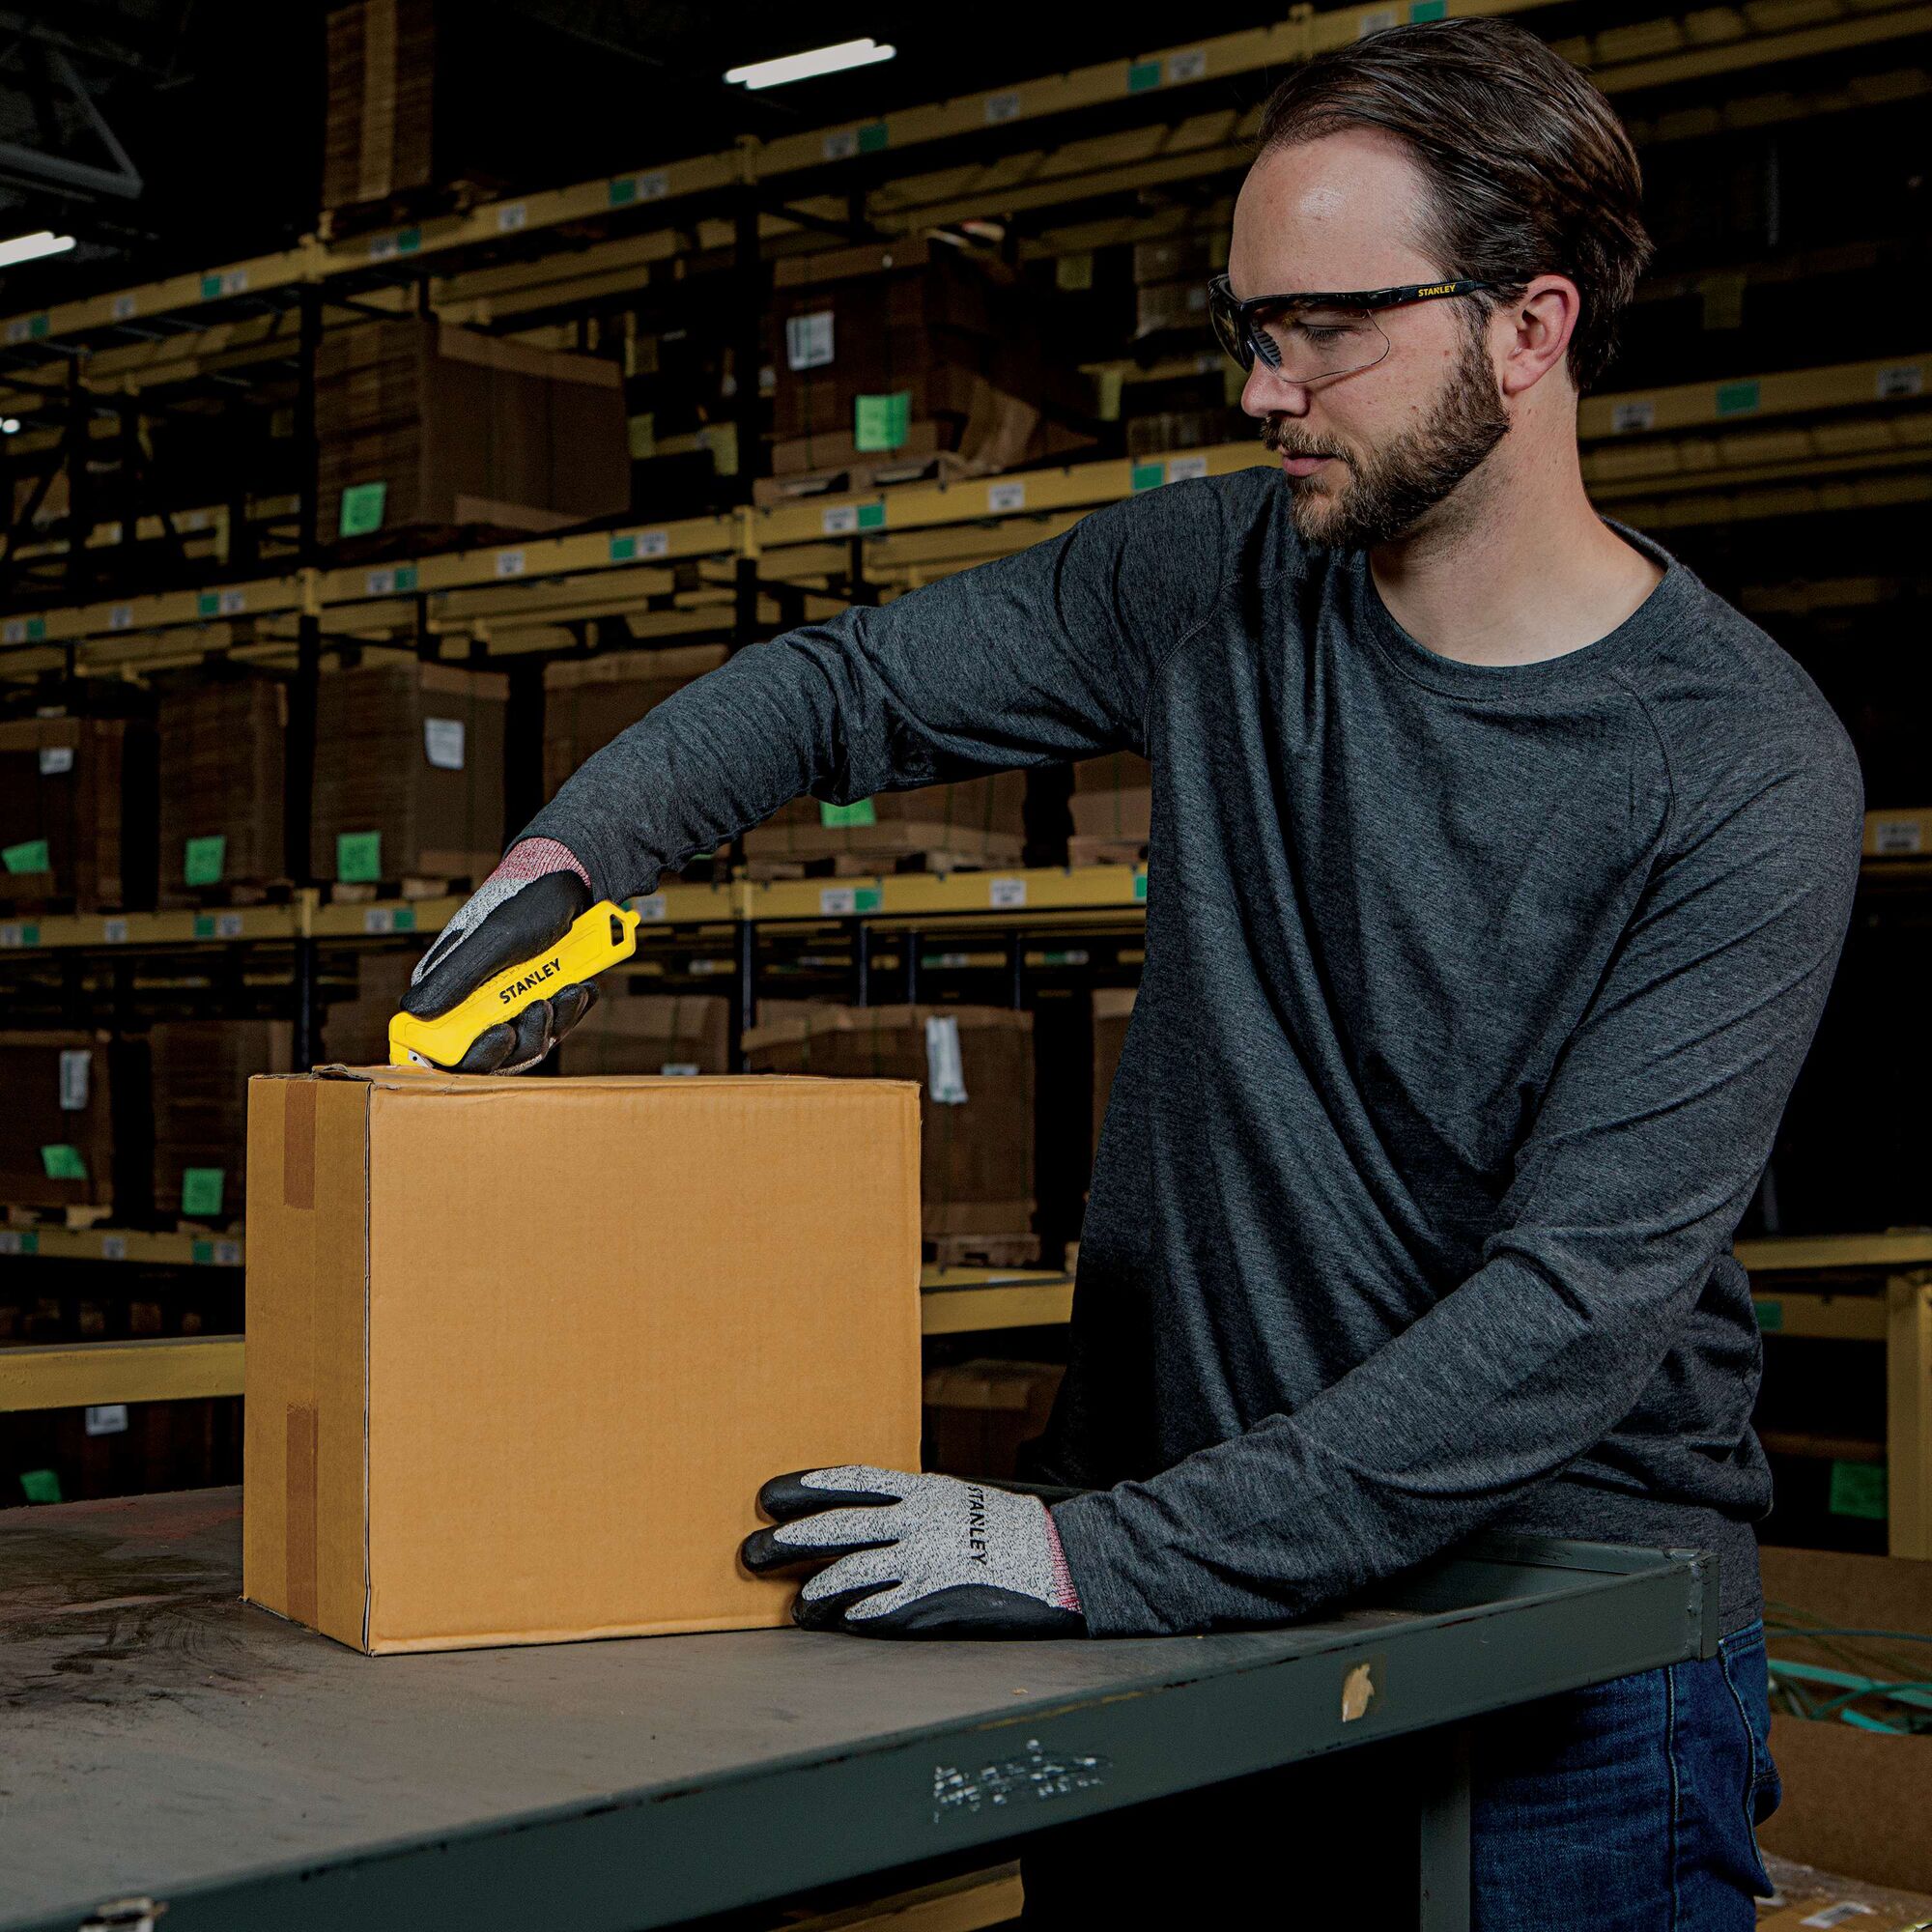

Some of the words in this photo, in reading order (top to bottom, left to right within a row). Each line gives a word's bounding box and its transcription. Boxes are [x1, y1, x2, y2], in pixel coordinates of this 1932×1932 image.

[1417, 284, 1456, 297] STANLEY
[498, 957, 560, 1004] STANLEY
[967, 1487, 986, 1566] STANLEY
